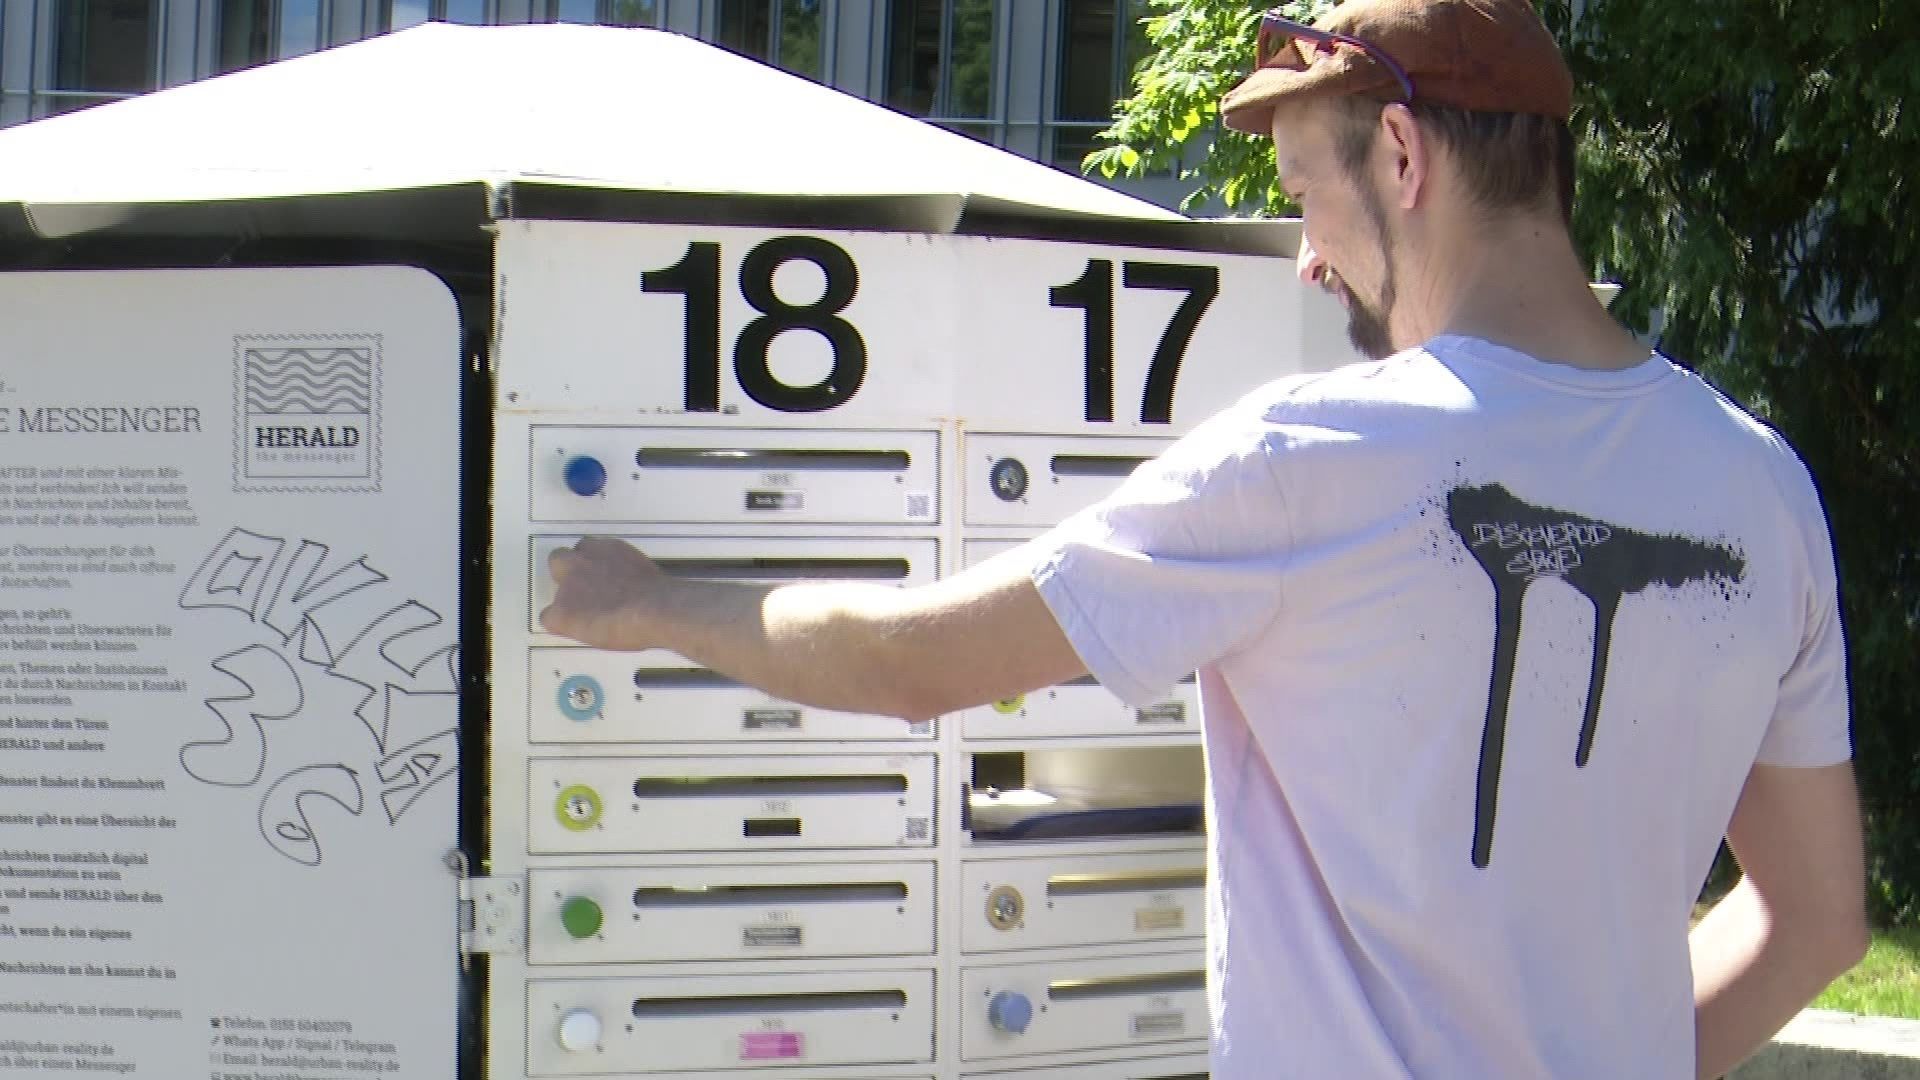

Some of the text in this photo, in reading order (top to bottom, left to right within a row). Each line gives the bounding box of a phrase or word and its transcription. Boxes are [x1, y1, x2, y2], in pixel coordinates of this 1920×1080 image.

[641, 235, 867, 412] 18
[1048, 258, 1220, 424] 17
[18, 407, 201, 432] MESSENGER
[256, 426, 360, 448] HERALD
